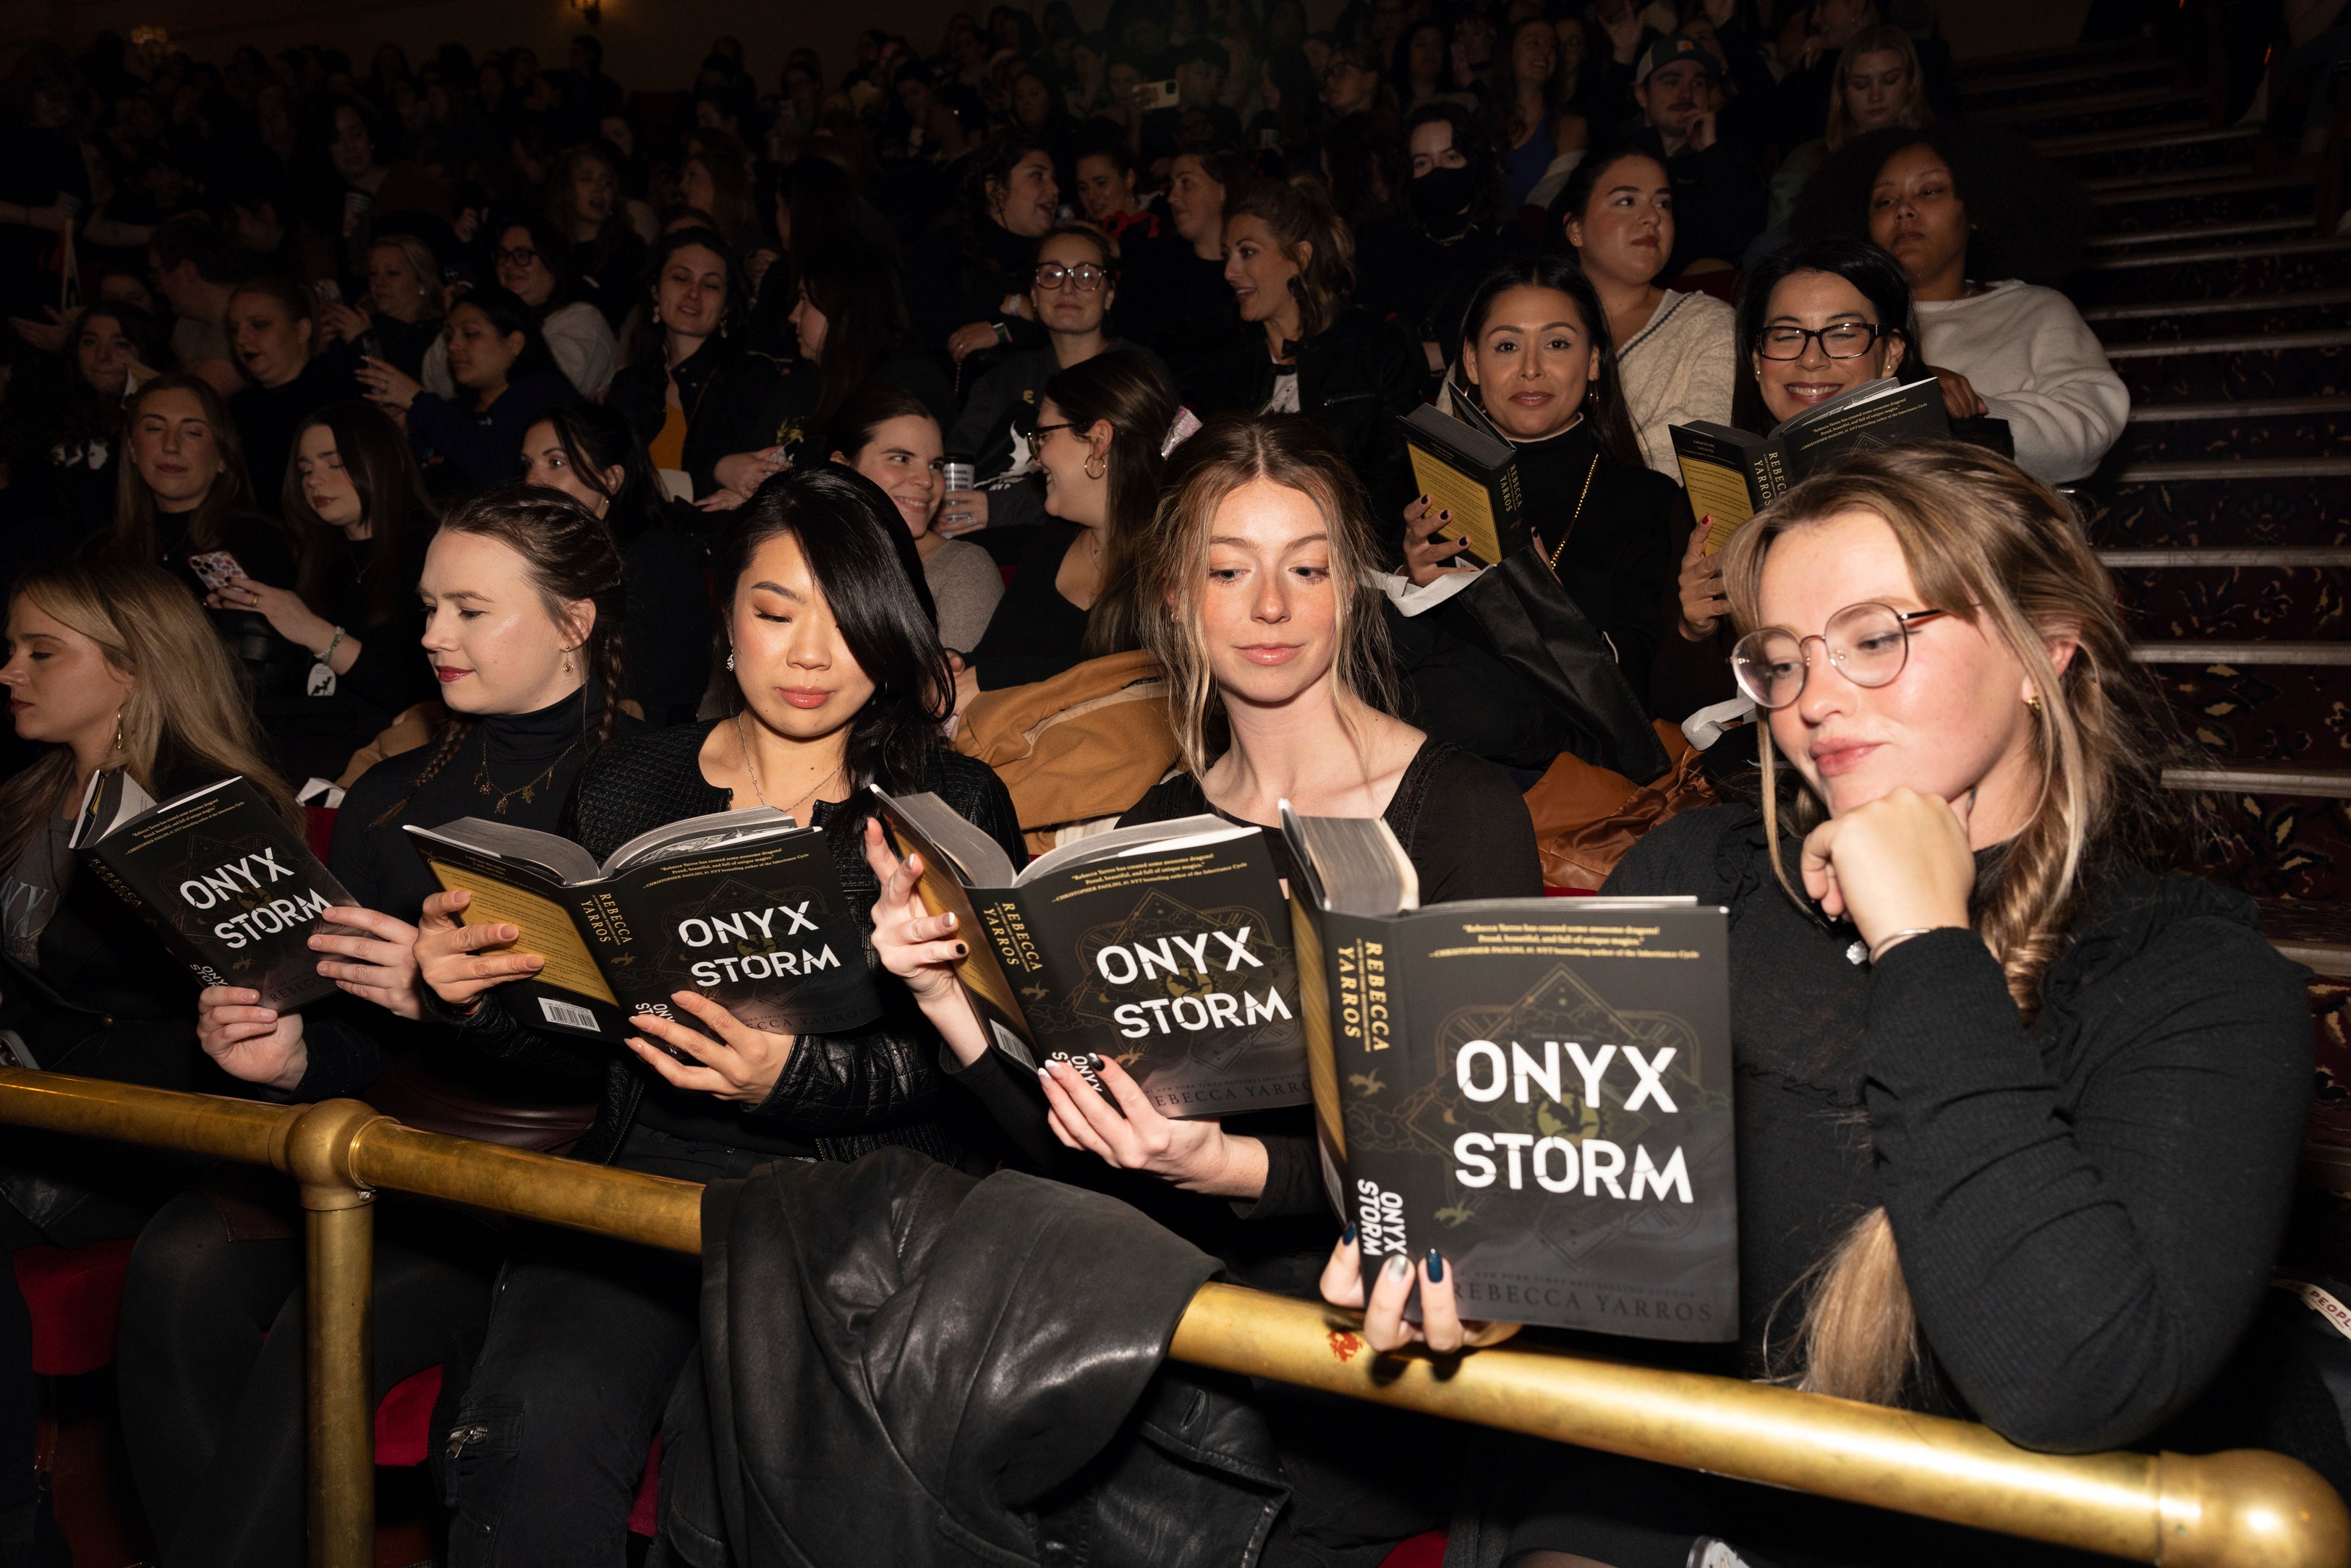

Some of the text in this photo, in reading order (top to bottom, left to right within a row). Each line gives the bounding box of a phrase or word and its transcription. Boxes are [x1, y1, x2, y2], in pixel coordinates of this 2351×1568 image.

[1500, 474, 1513, 512] YARROS
[1510, 464, 1523, 508] REBECCA
[1753, 459, 1774, 506] YARROS
[1769, 451, 1787, 498] REBEC
[92, 858, 143, 906] REBECCA
[179, 847, 295, 910] ONYX
[214, 887, 333, 949] STORM
[580, 900, 612, 942] YARROS
[599, 892, 634, 943] REBECCA
[677, 900, 821, 948] ONYX
[983, 908, 1020, 965] YARROS
[1001, 902, 1043, 970] REBECCA
[202, 966, 231, 987] ONY
[690, 943, 841, 987] STORM
[1096, 926, 1264, 984] ONYX
[652, 1003, 676, 1022] ONY
[800, 1007, 869, 1026] YARROS
[1113, 986, 1293, 1038] STORM
[1338, 946, 1362, 1039] YARROS
[1364, 940, 1390, 1052] REBECCA
[1155, 1088, 1238, 1107] EBECCA
[1455, 1039, 1678, 1113] ONYX
[1453, 1132, 1694, 1203] STORM
[1357, 1178, 1383, 1256] STORM
[1379, 1191, 1408, 1255] ONYX
[1454, 1282, 1581, 1310] REBECCA
[1597, 1295, 1712, 1321] YARROS
[2310, 1291, 2351, 1330] PEOPL
